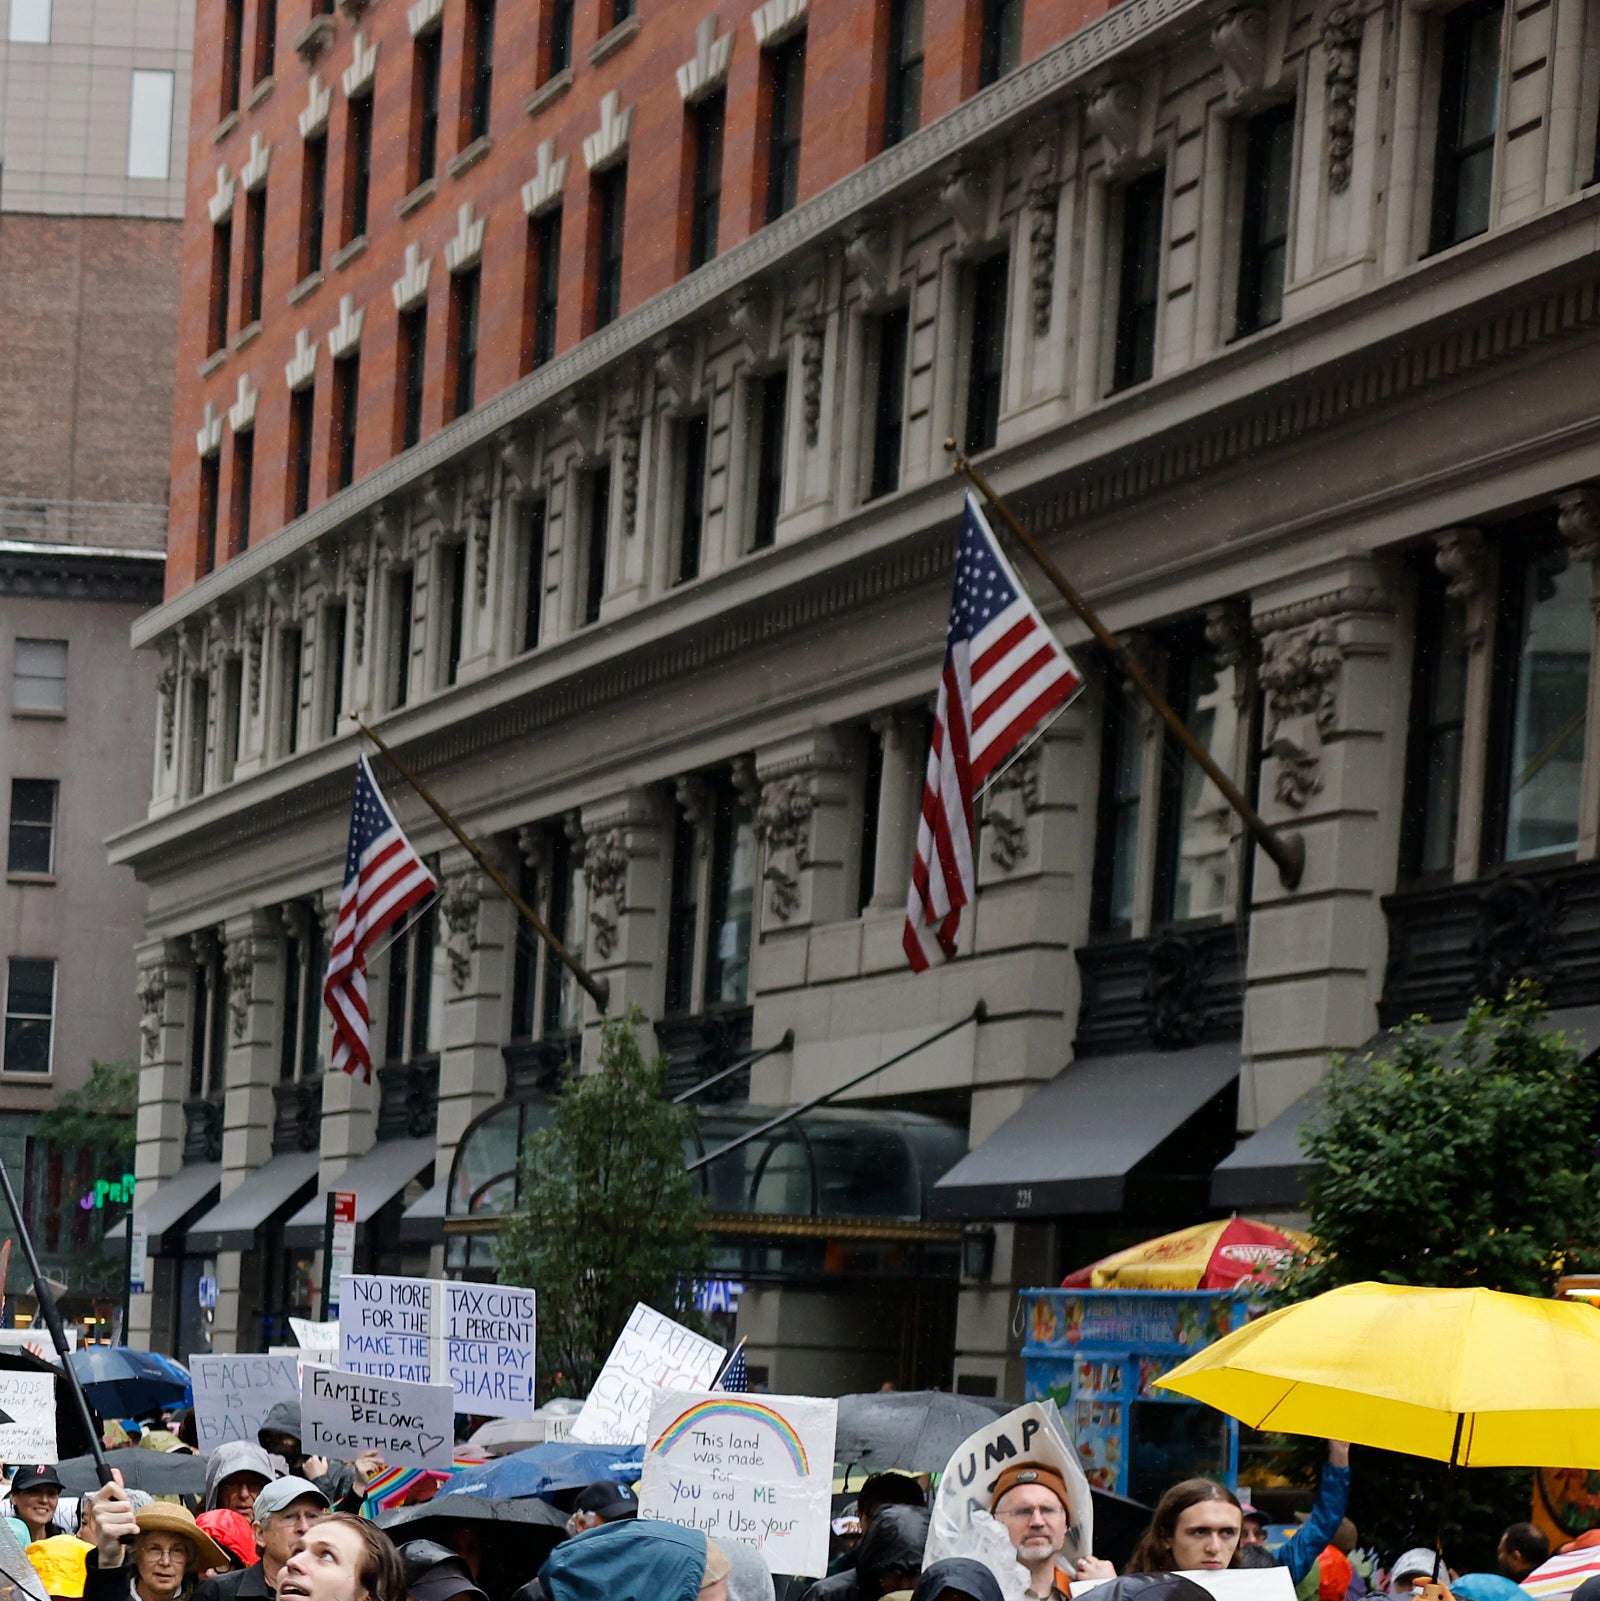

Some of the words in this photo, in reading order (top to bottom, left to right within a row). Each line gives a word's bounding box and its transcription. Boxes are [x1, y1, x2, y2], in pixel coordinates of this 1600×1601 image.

[353, 1280, 383, 1303] NO
[390, 1284, 432, 1310] MORE
[447, 1288, 484, 1314] TAX
[487, 1293, 534, 1320] CUTS
[362, 1308, 394, 1329] FOR
[398, 1311, 429, 1334] THE
[450, 1317, 461, 1338] 1
[465, 1318, 534, 1344] PERCENT
[627, 1308, 653, 1337] I
[649, 1318, 724, 1373] PREFER
[346, 1334, 394, 1357] MAKE
[398, 1336, 430, 1358] THE
[448, 1342, 492, 1366] RICH
[497, 1346, 532, 1371] PAY
[312, 1371, 402, 1408] FAMILIES
[449, 1367, 534, 1403] SHARE!
[226, 1394, 243, 1408] IS
[350, 1404, 424, 1430] BELONG
[311, 1422, 415, 1453] TOGETHER
[691, 1431, 724, 1449] This
[729, 1431, 760, 1450] land
[692, 1452, 723, 1466] was
[728, 1451, 765, 1467] made
[710, 1467, 733, 1482] for
[670, 1479, 702, 1503] YOU
[713, 1487, 736, 1502] and
[753, 1487, 778, 1505] ME
[700, 1508, 721, 1537] up!
[728, 1510, 757, 1533] Use
[761, 1515, 799, 1540] your
